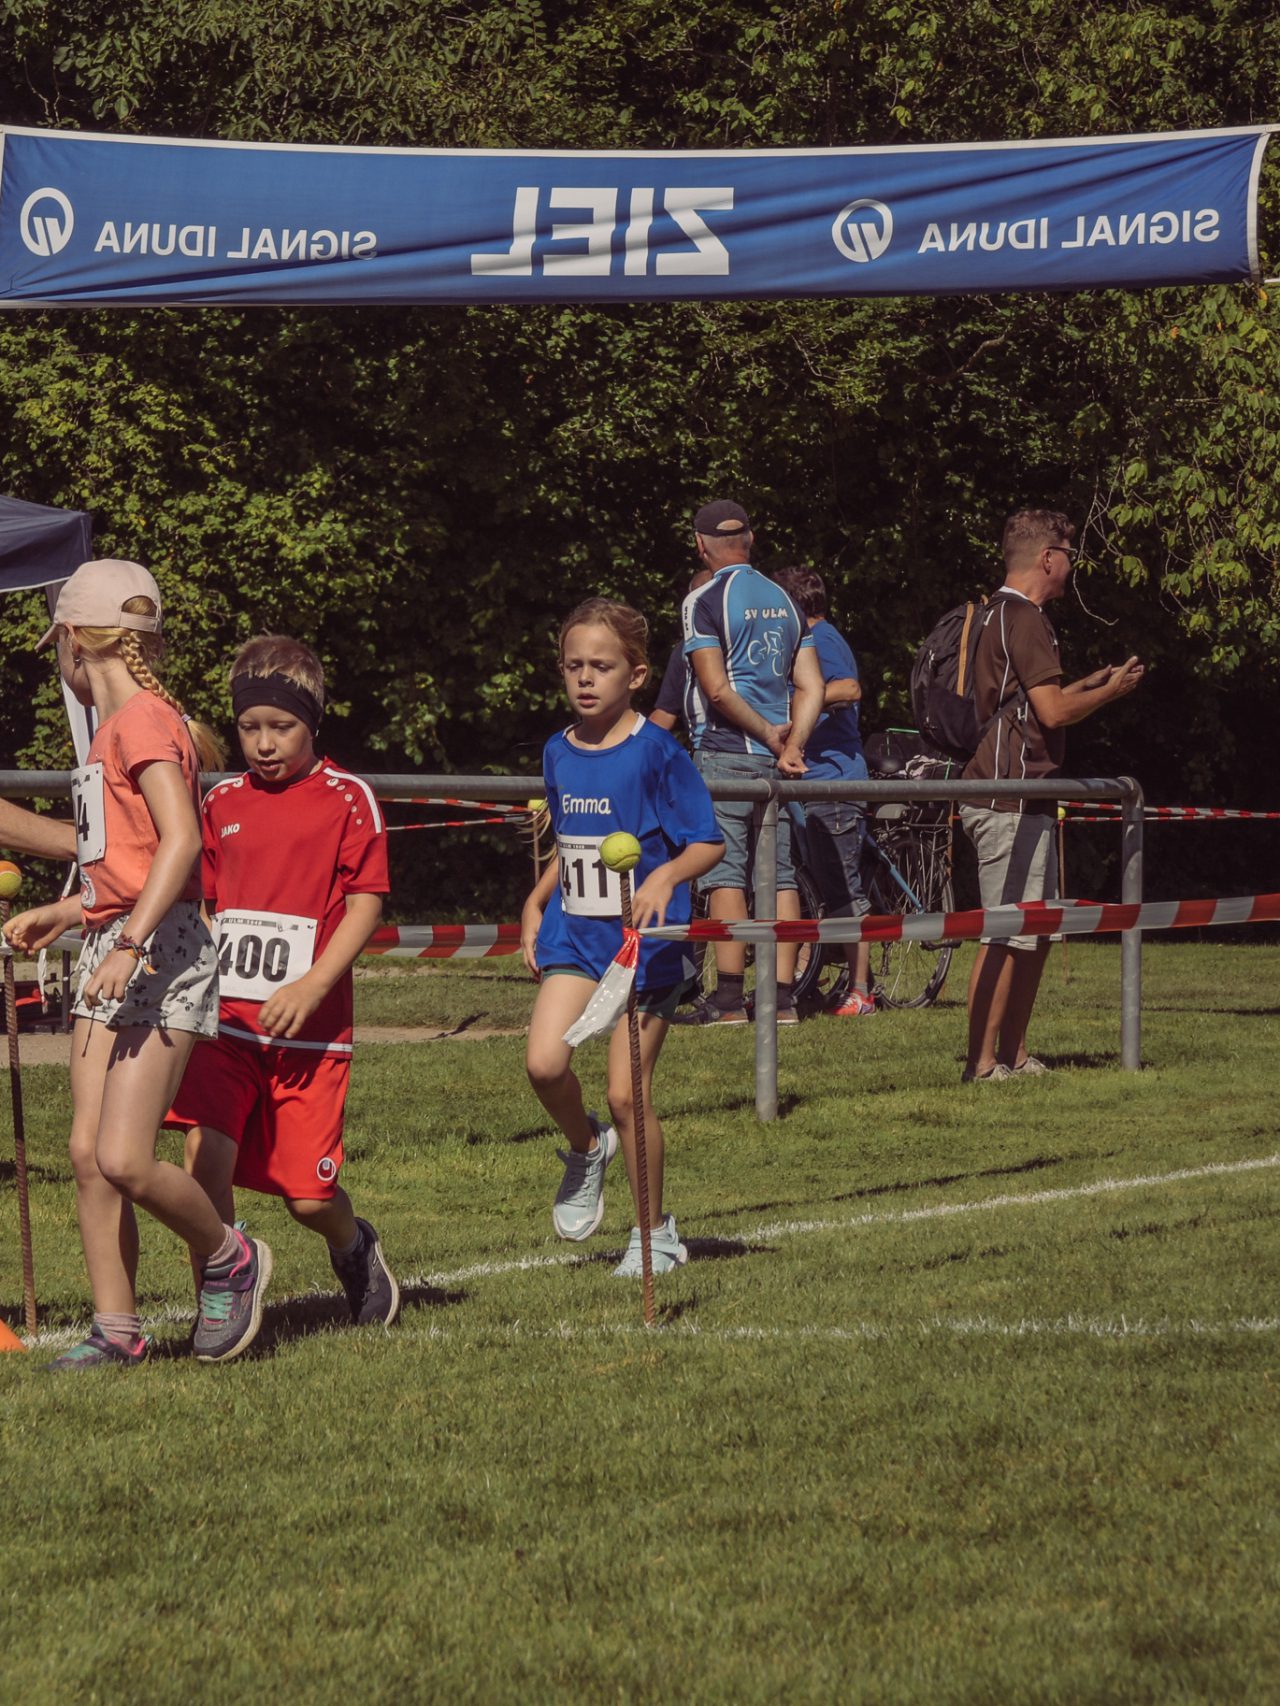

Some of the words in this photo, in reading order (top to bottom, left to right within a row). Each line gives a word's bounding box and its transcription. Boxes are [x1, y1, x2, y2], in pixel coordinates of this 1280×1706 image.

[744, 608, 758, 620] SV
[762, 607, 788, 619] ULM
[562, 794, 612, 815] Emma
[221, 823, 241, 839] JAKO
[218, 933, 291, 983] 400
